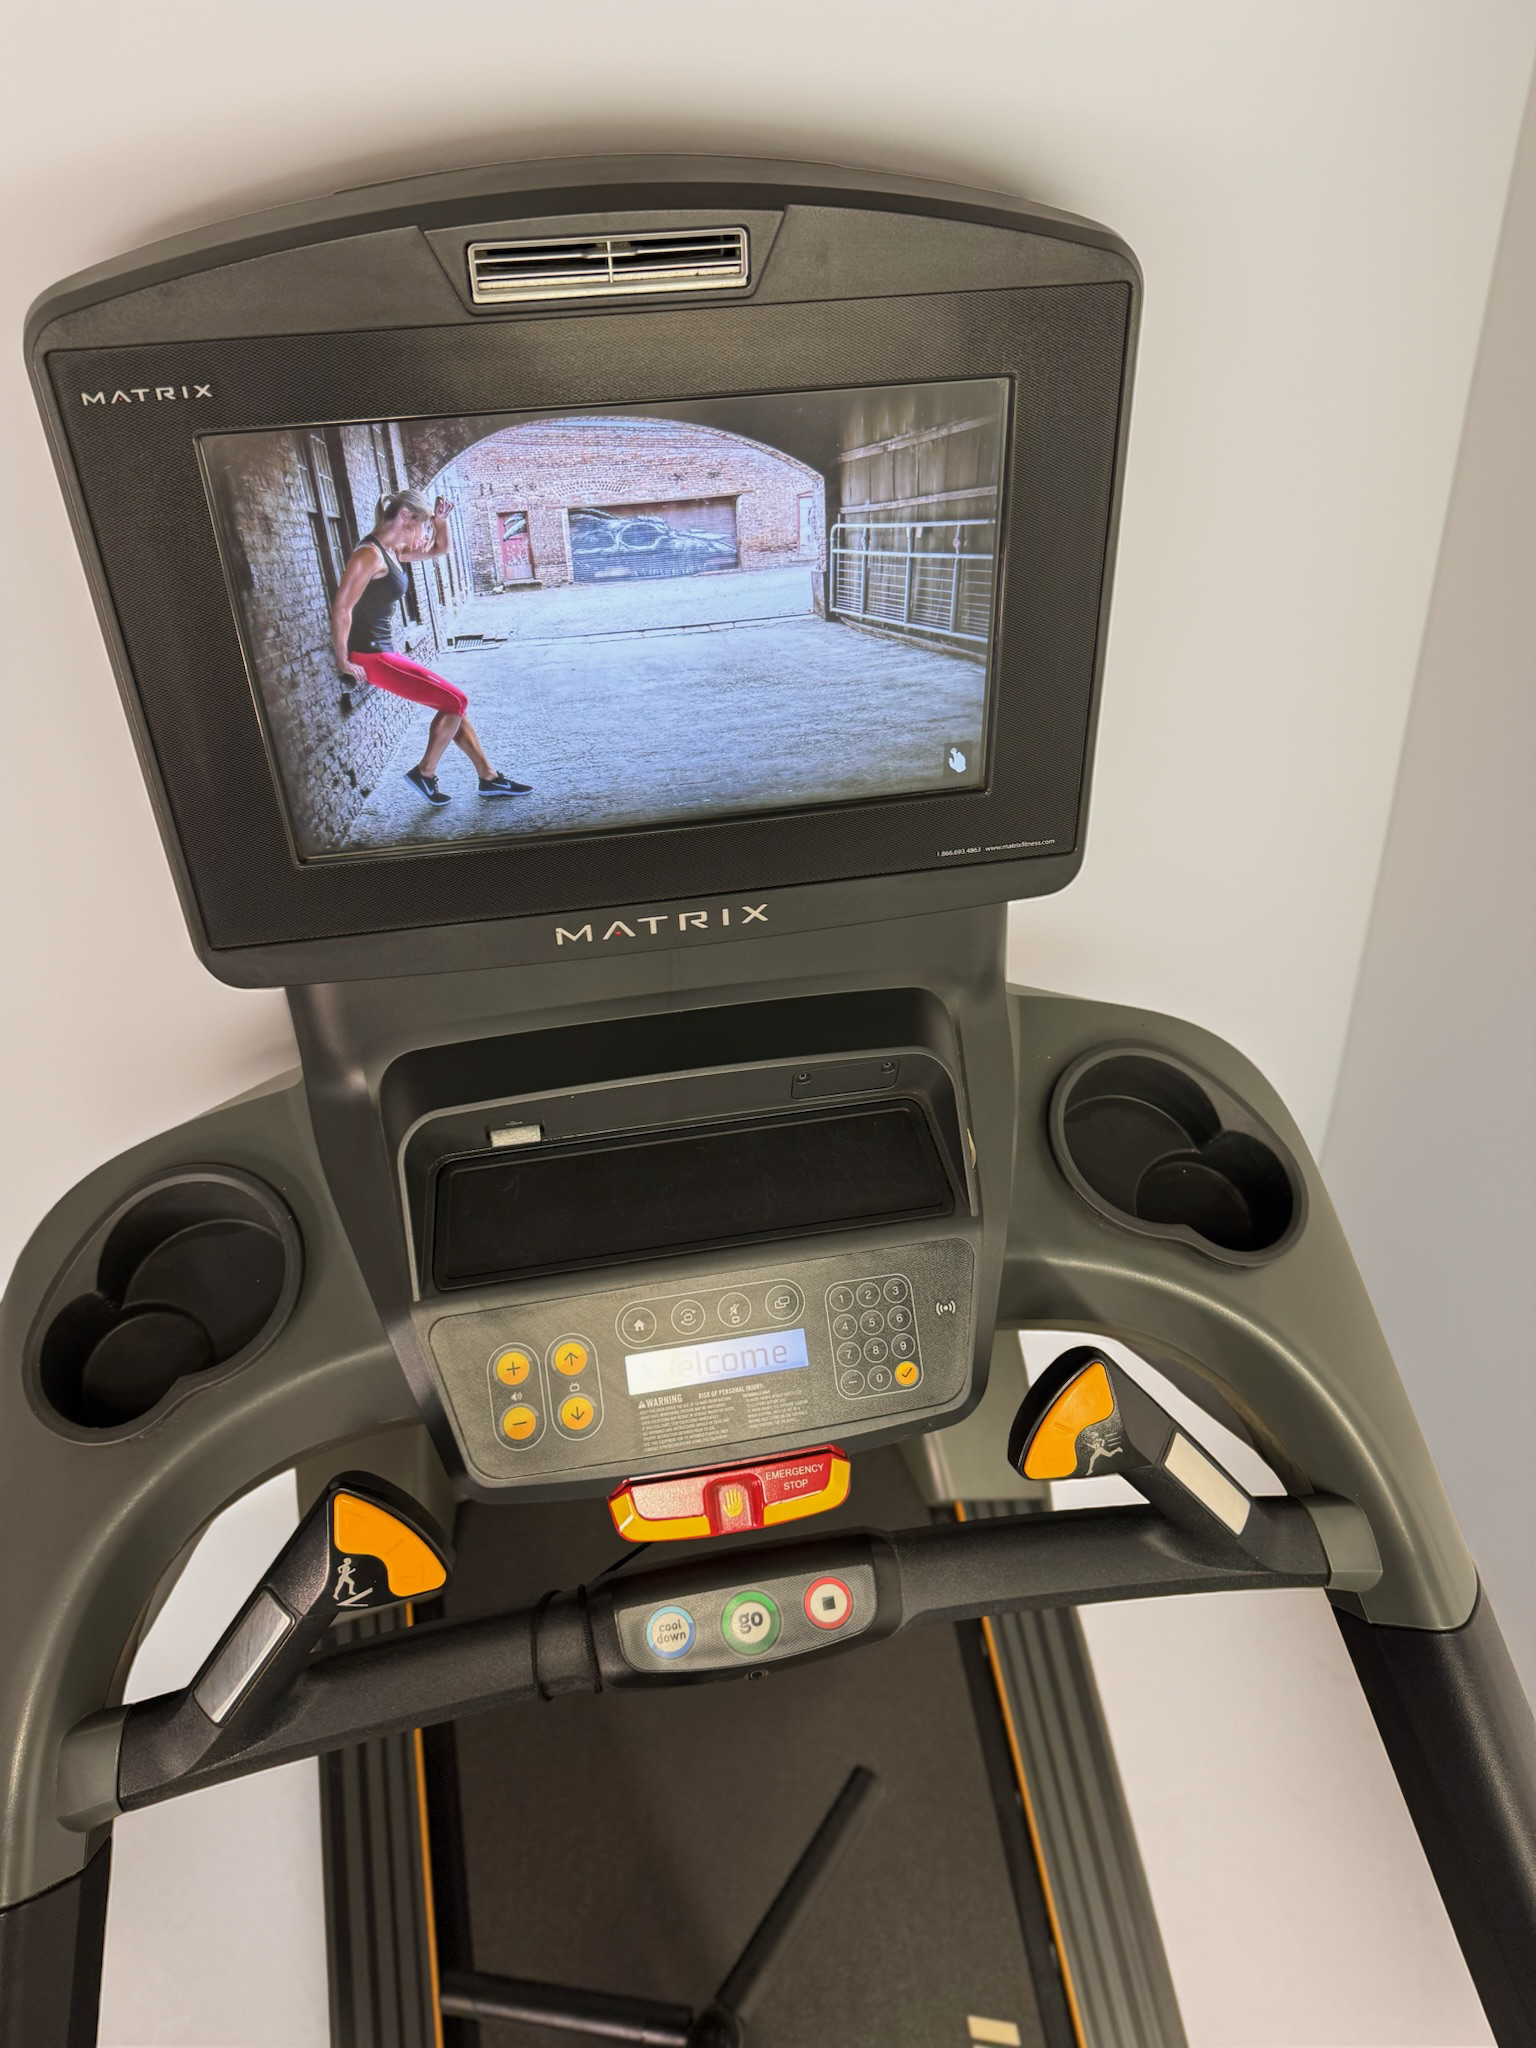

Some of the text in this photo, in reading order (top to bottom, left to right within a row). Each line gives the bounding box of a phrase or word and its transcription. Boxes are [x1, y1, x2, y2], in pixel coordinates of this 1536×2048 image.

[81, 384, 213, 406] MATRIX
[985, 838, 1056, 852] www.matrixfitness.com
[555, 903, 769, 945] MATRIX
[839, 1285, 899, 1304] 1 2 3
[842, 1313, 903, 1331] 4 5 6
[845, 1341, 907, 1359] 7 8 9
[645, 1394, 683, 1408] WARNING
[698, 1392, 711, 1400] RISK
[710, 1390, 718, 1398] OF
[718, 1386, 745, 1397] PERSONAL
[765, 1463, 824, 1481] EMERGENCY
[783, 1478, 809, 1491] STOP
[658, 1620, 682, 1632] cool
[738, 1610, 763, 1635] go
[656, 1629, 687, 1644] down
